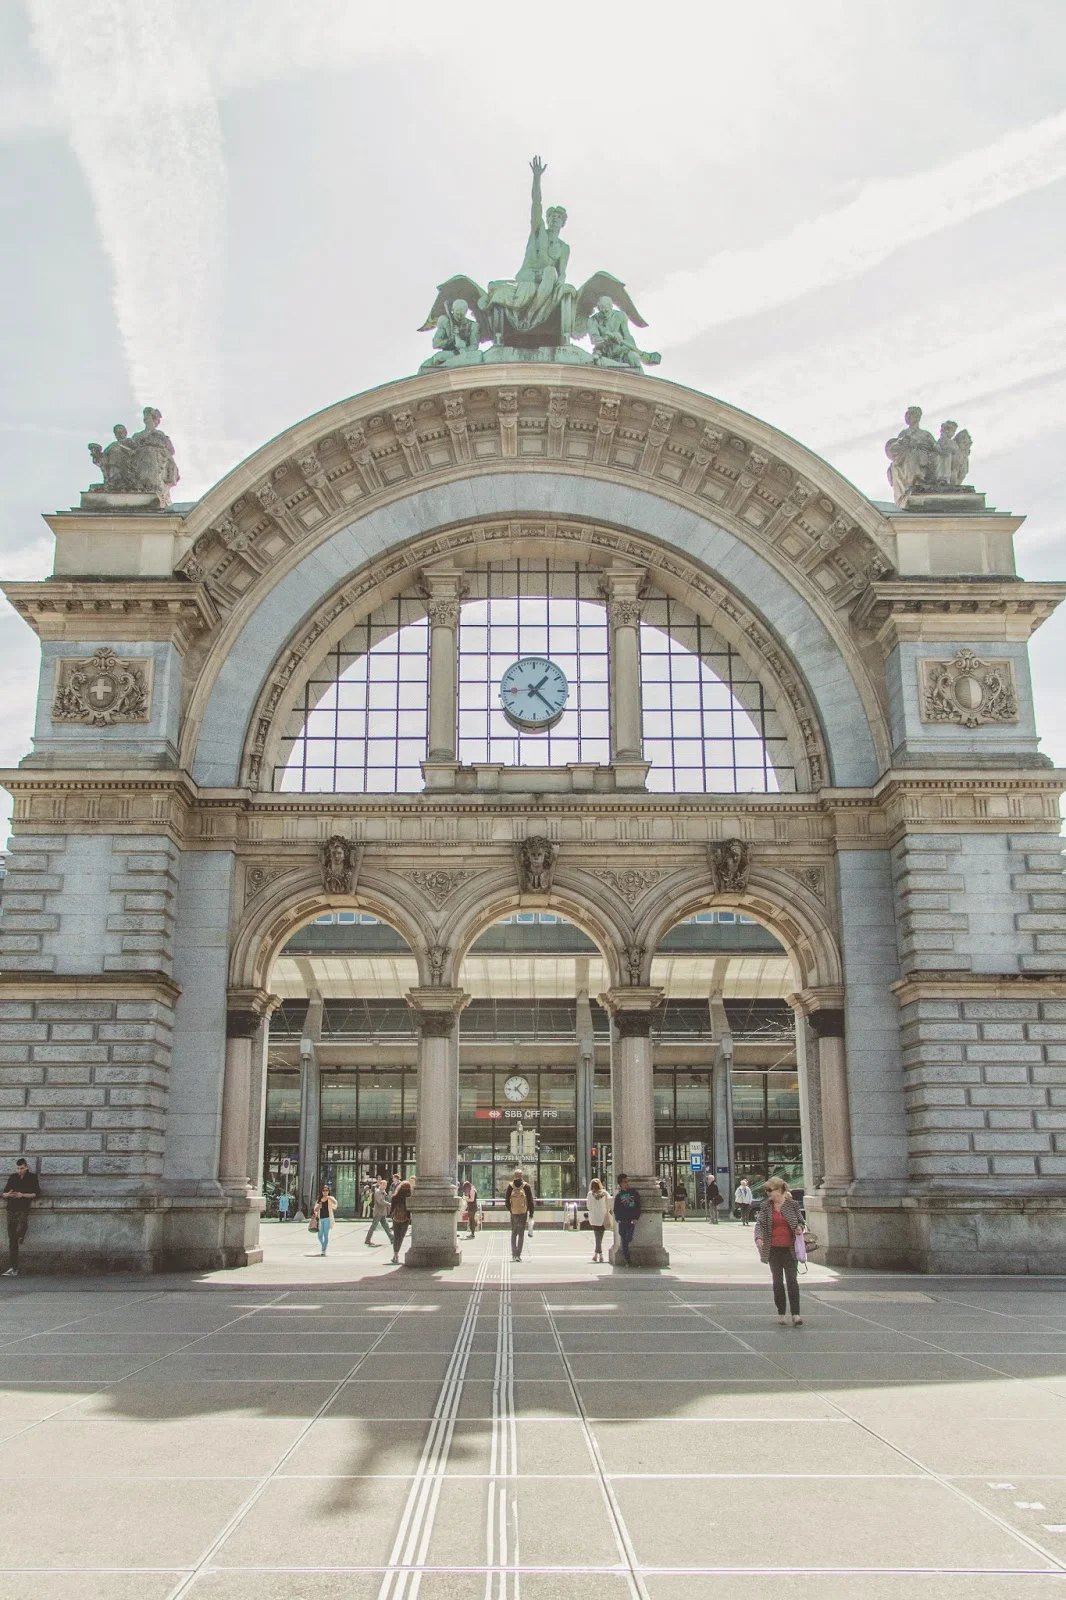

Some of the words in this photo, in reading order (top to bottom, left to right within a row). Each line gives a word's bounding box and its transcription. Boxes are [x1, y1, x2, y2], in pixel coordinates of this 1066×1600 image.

[504, 1110, 522, 1118] SBB
[525, 1110, 541, 1118] CFF
[542, 1110, 558, 1118] FFS
